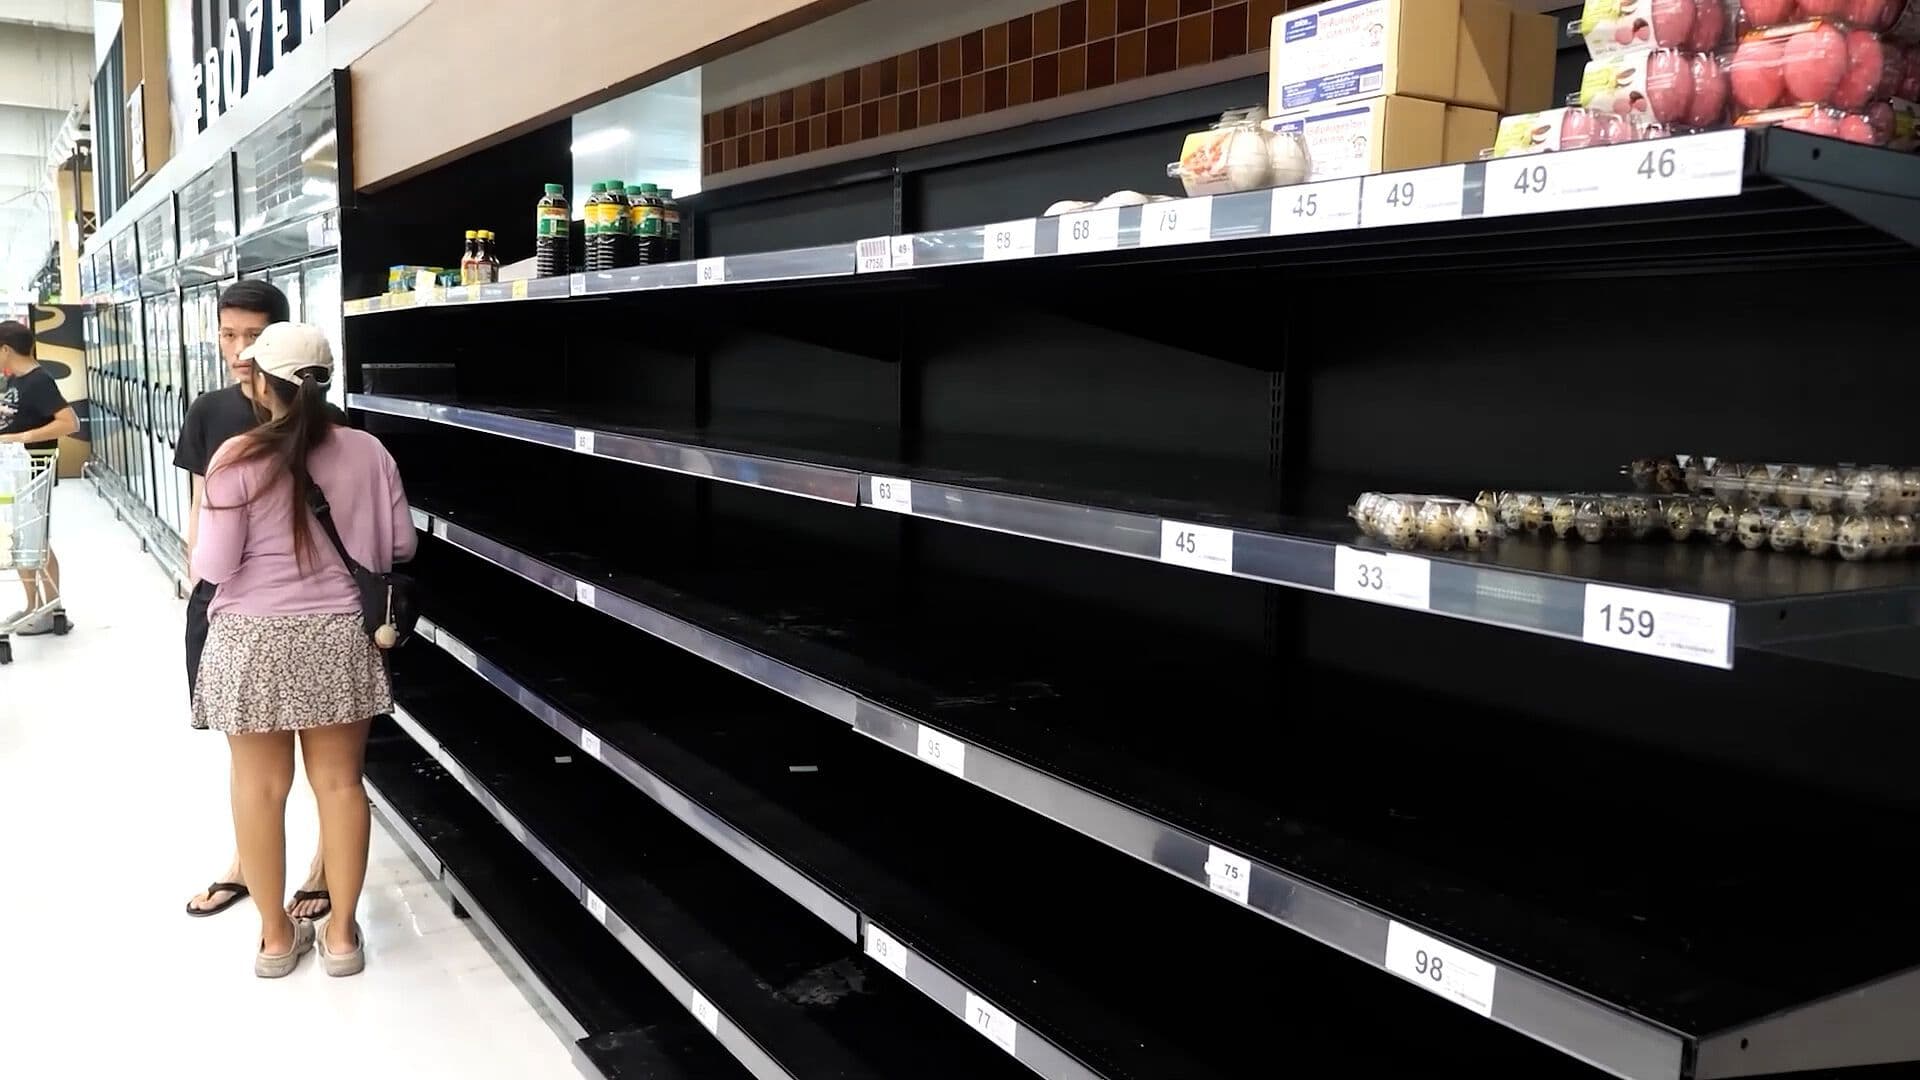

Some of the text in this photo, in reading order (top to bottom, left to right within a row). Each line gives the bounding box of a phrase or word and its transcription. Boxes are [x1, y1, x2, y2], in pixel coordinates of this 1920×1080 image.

[1637, 147, 1676, 179] 46
[1514, 165, 1548, 194] 49
[1292, 193, 1317, 217] 45
[1386, 182, 1415, 207] 49
[1073, 219, 1090, 240] 68
[879, 482, 891, 499] 63
[1175, 531, 1196, 554] 45
[1358, 564, 1384, 590] 33
[1600, 603, 1655, 638] 159
[928, 739, 941, 759] 95
[1225, 863, 1239, 879] 75
[876, 938, 887, 957] 69
[1415, 950, 1443, 981] 98
[977, 1007, 991, 1028] 77
